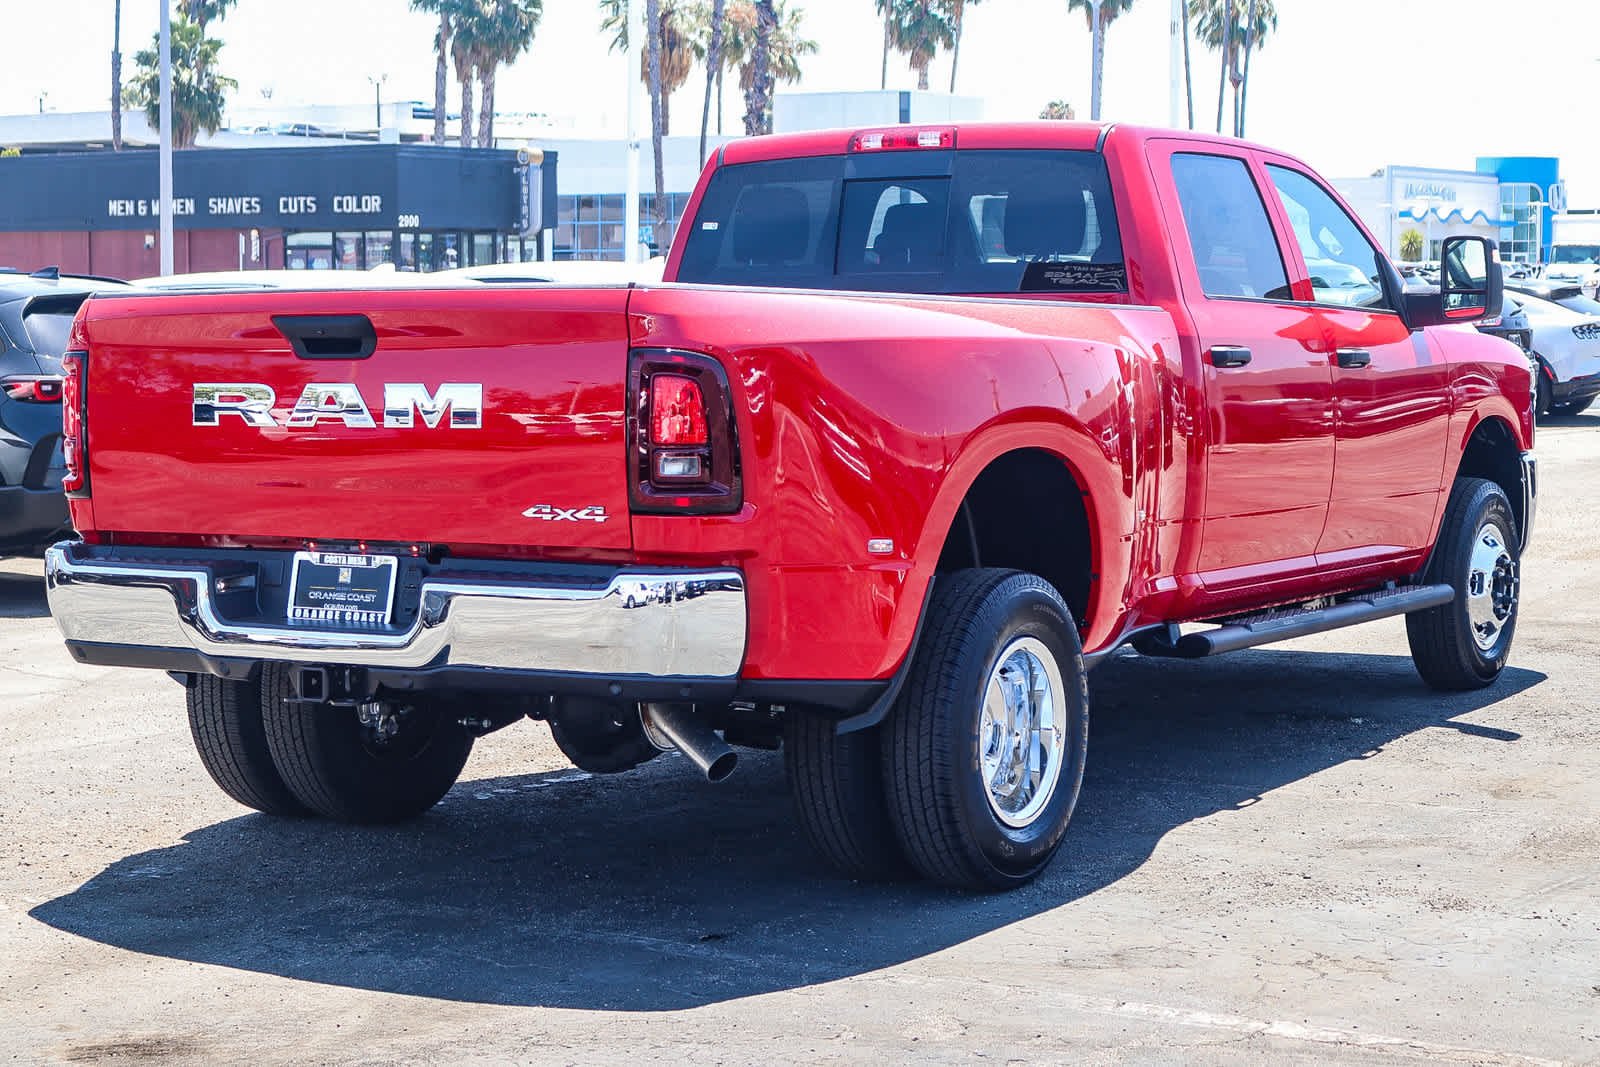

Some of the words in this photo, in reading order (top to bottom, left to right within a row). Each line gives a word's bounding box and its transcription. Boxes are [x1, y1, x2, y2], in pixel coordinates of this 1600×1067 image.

[108, 199, 135, 216] MEN
[137, 199, 148, 216] &
[151, 198, 195, 216] WMEN
[208, 197, 261, 214] SHAVES
[279, 196, 317, 214] CUTS
[333, 195, 382, 213] COLOR
[191, 383, 483, 429] RAM
[521, 504, 609, 522] 4x4
[324, 554, 347, 565] COSTA
[308, 591, 346, 601] ORANGE
[346, 593, 377, 602] COAST
[294, 608, 341, 620] ORANGE
[344, 611, 384, 624] COAST
